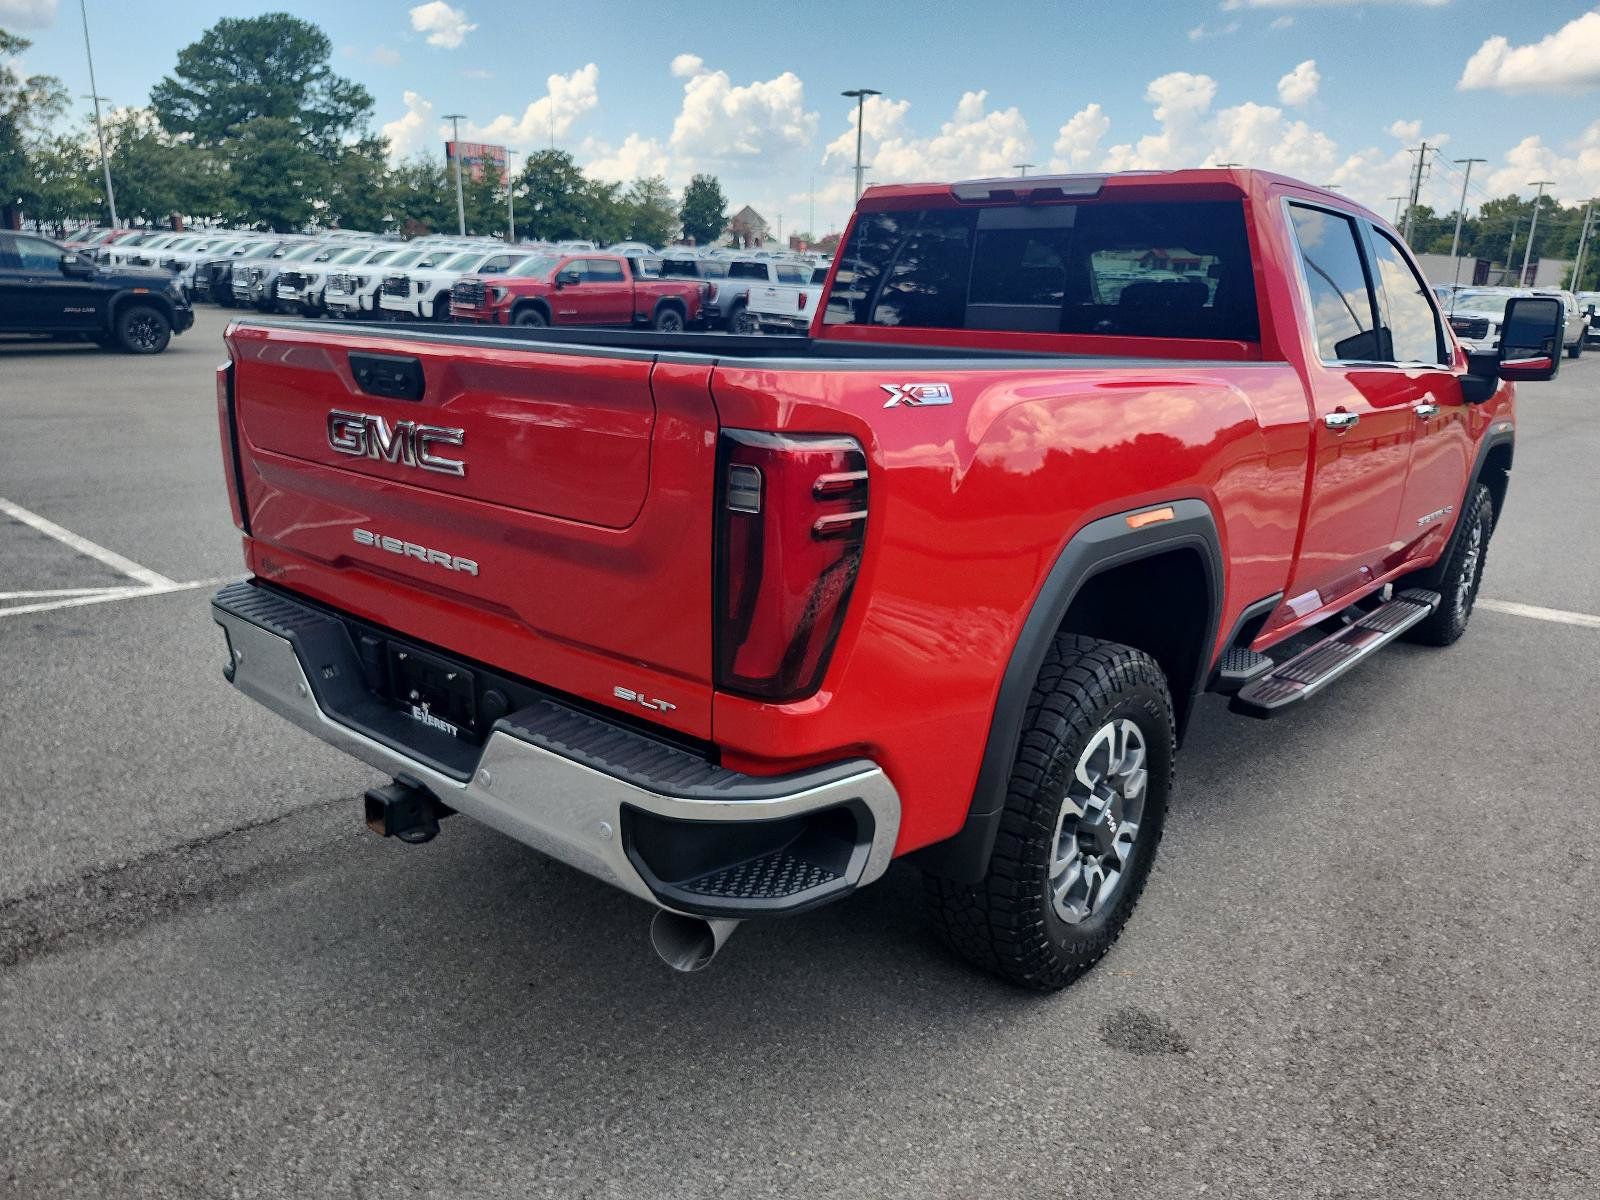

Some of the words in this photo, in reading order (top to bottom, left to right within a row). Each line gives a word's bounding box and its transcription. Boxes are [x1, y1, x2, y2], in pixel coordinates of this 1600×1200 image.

[327, 408, 465, 477] GMC
[352, 528, 480, 577] SIERRA
[613, 686, 677, 713] SLT
[412, 705, 458, 737] EVERETT
